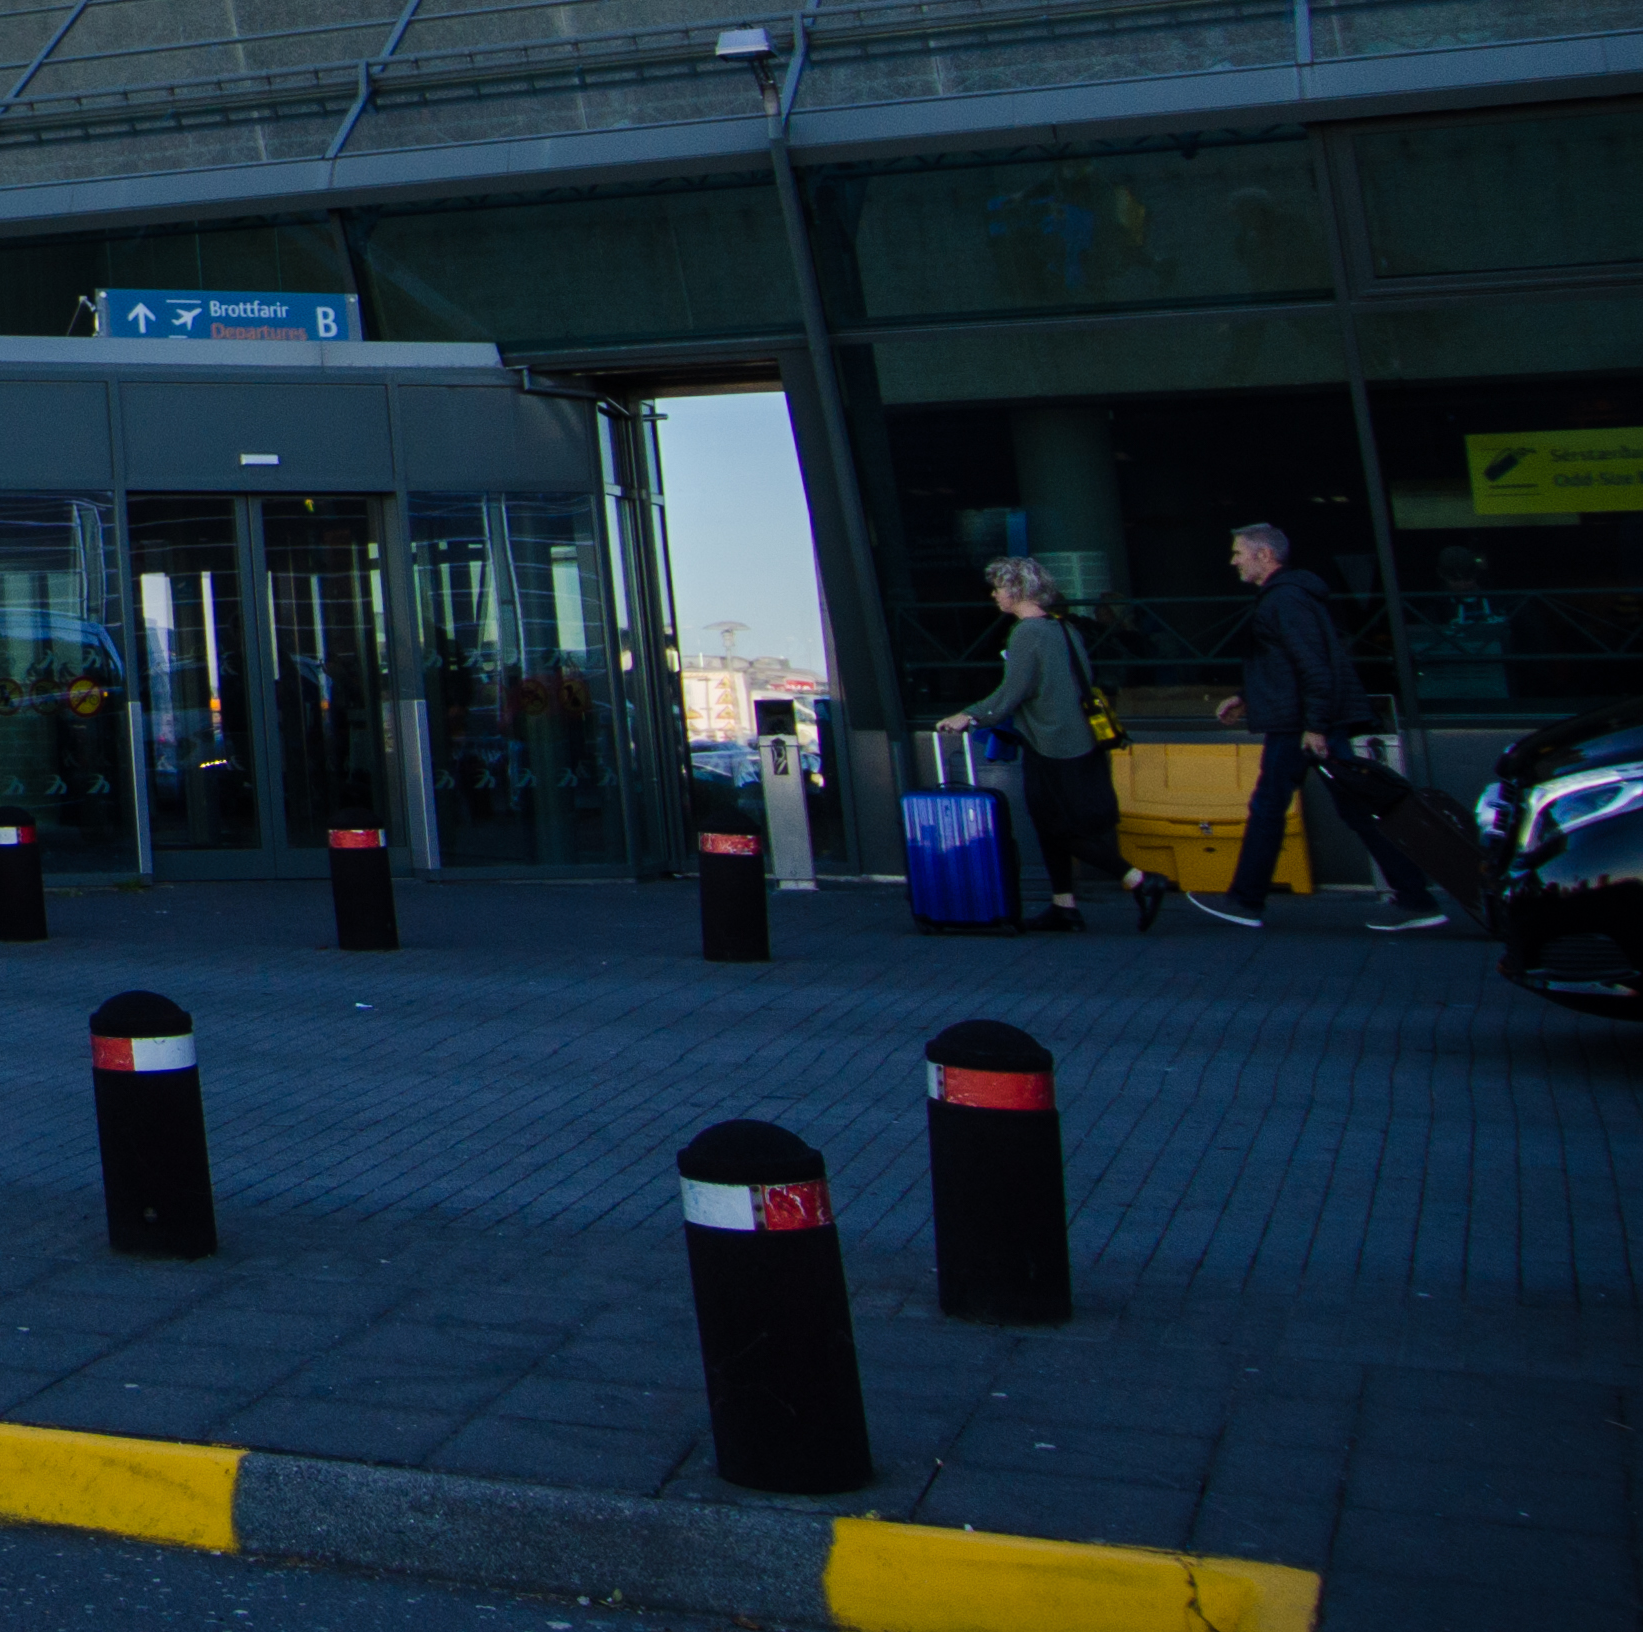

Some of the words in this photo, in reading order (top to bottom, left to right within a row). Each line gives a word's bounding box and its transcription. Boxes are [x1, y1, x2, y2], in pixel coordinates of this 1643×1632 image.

[209, 299, 289, 318] Brottfarir
[316, 306, 339, 338] B
[210, 322, 309, 340] Departures
